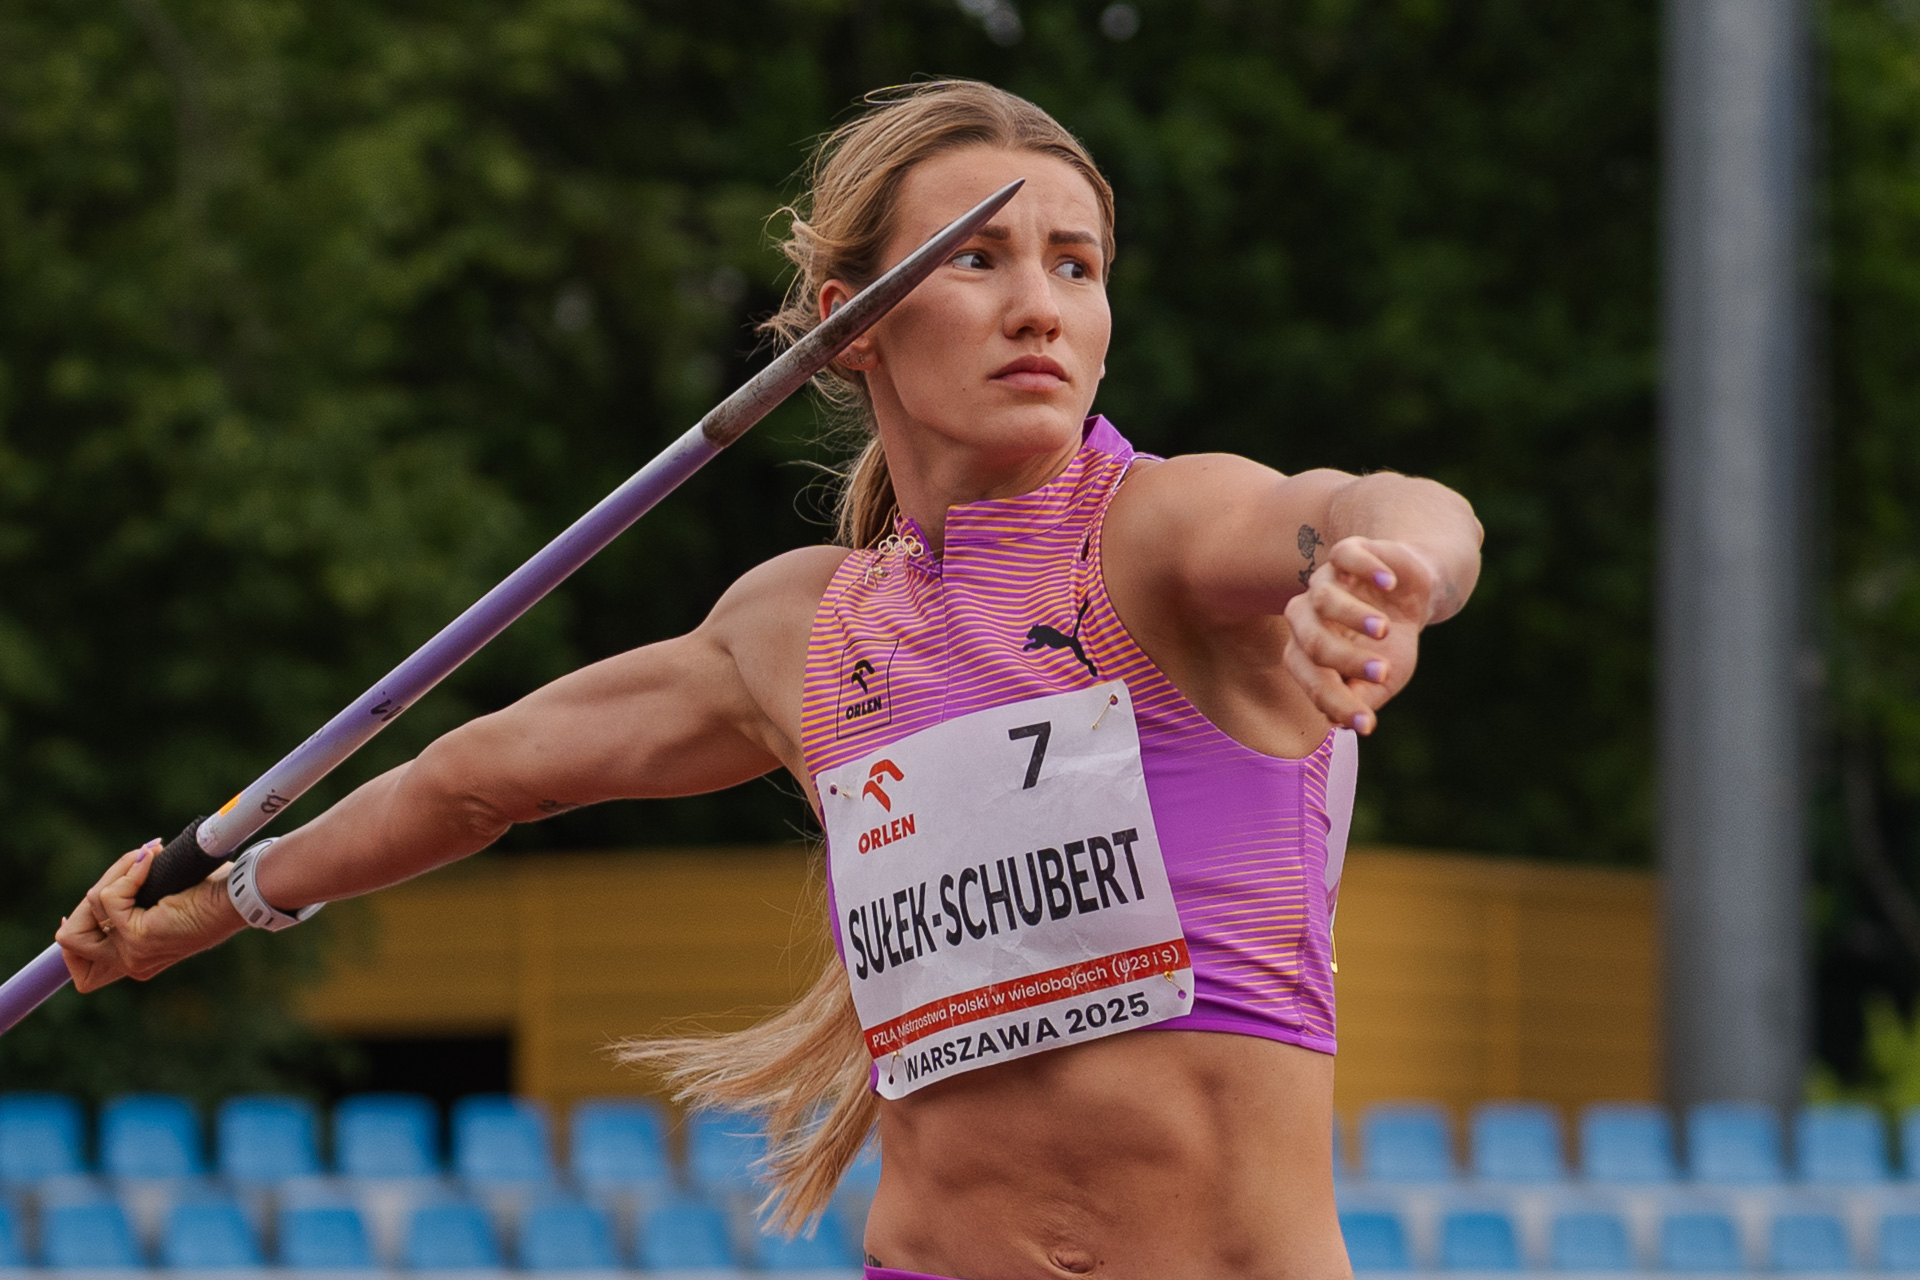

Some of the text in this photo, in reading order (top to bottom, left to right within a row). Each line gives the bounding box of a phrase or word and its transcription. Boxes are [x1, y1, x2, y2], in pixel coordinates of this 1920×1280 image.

[846, 696, 882, 720] ORLEN
[1008, 721, 1051, 790] 7
[858, 813, 916, 854] ORLEN
[848, 827, 1146, 980] SUŁEK-SCHUBERT
[871, 1028, 898, 1048] PZLA
[949, 994, 989, 1017] Polski
[992, 993, 1005, 1006] w
[1008, 966, 1108, 1002] wielobojach
[1111, 953, 1150, 978] (U23
[1152, 951, 1159, 965] i
[1161, 944, 1179, 964] S)
[903, 991, 1149, 1083] WARSZAWA 2025
